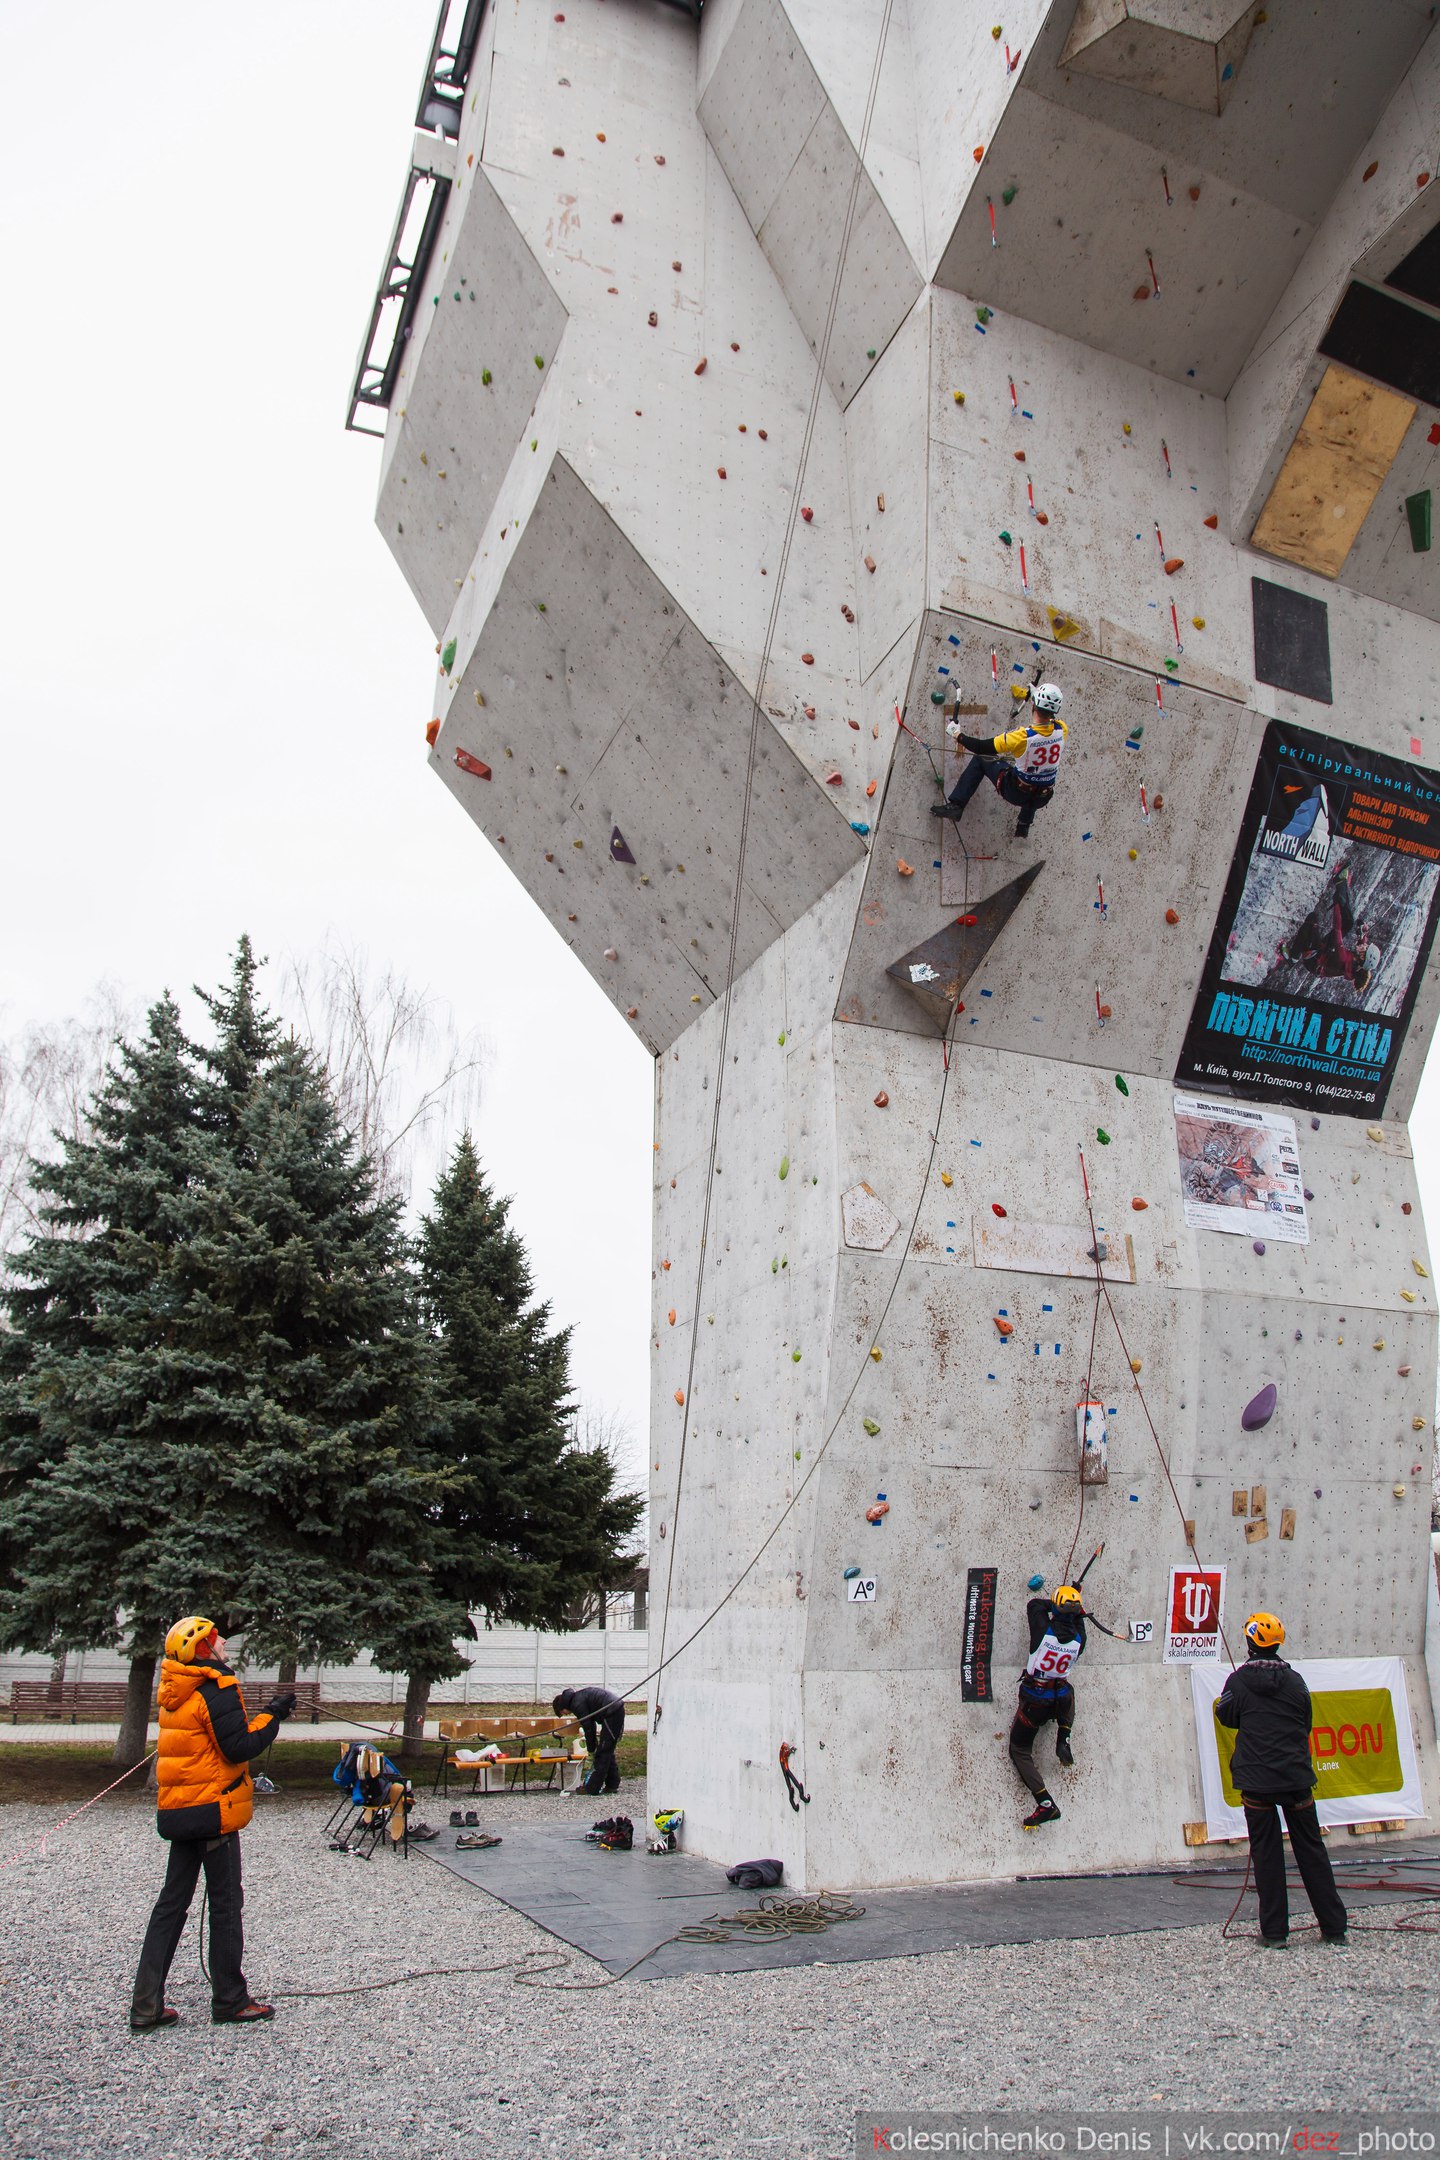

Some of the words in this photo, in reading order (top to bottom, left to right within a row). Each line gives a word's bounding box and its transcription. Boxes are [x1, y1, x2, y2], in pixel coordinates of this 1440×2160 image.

[1032, 744, 1060, 766] 38
[1279, 744, 1412, 793] екіпірувальний
[1347, 807, 1394, 830] АЛЬПІНІЗМУ
[1352, 791, 1381, 810] ТОВАРИ
[1380, 801, 1398, 816] ДЛЯ
[1398, 805, 1430, 825] ТУРИЗМУ
[1262, 829, 1300, 856] NORTH
[1301, 840, 1325, 863] WALL
[1343, 822, 1353, 834] ТА
[1353, 826, 1397, 847] АКТИВНОГО
[1396, 838, 1440, 860] ВІДПОЧИНКУ
[1241, 1042, 1381, 1082] http://northwall.com.ua
[1193, 1063, 1204, 1072] м.
[1206, 1063, 1229, 1078] Київ,
[1304, 1081, 1313, 1093] 9,
[1315, 1083, 1376, 1103] (044)222-75-68
[969, 1585, 979, 1620] ultimate
[965, 1622, 976, 1663] mountain
[975, 1573, 994, 1697] krukonogi.com
[1170, 1637, 1189, 1648] TOP
[1190, 1637, 1217, 1648] POINT
[1040, 1650, 1072, 1674] 56
[1168, 1648, 1217, 1658] skalainfo.com
[963, 1664, 973, 1685] gear
[1308, 1722, 1383, 1758] DON
[1316, 1761, 1340, 1771] Lanex
